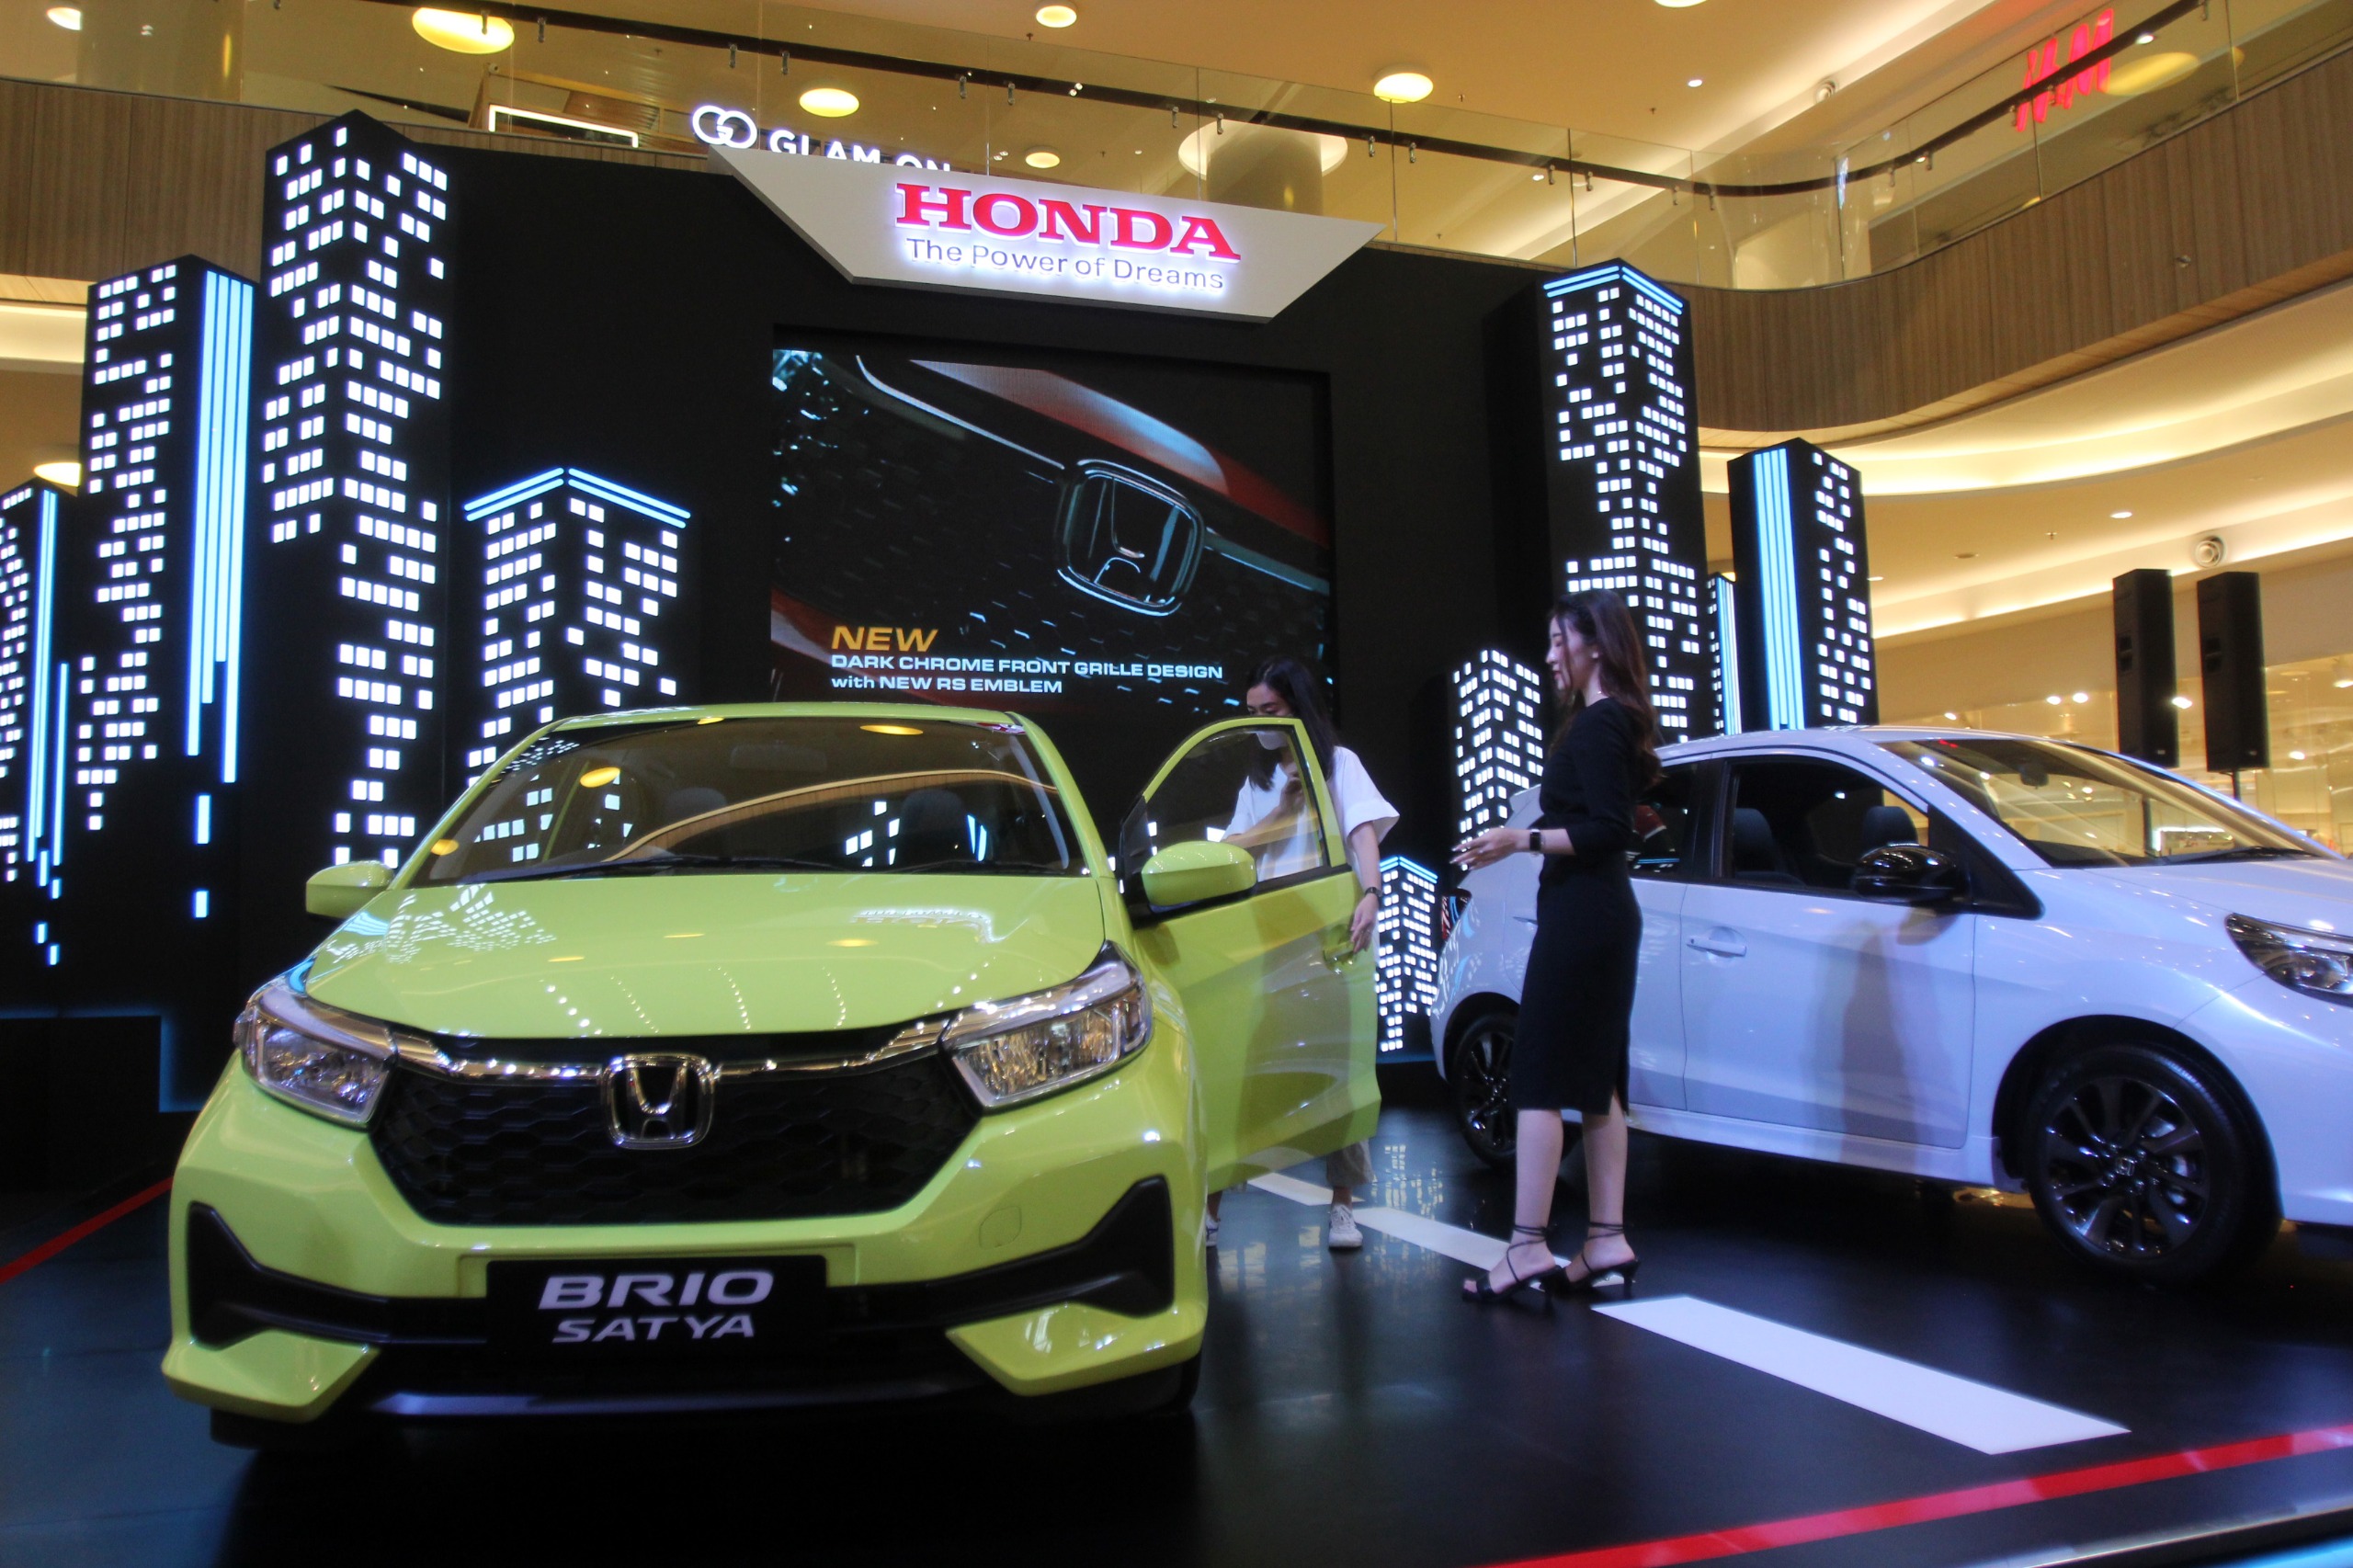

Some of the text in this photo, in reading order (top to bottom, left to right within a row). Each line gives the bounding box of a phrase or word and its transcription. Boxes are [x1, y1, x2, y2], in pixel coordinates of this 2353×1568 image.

[895, 182, 1242, 263] HONDA
[905, 237, 1223, 290] The Power of Dreams
[831, 625, 938, 653] NEW
[831, 654, 1222, 678] DARK CHROME FRONT GRILLE DESIGN
[831, 676, 1063, 693] with NEW RS EMBLEM
[538, 1270, 774, 1310] BRIO
[551, 1314, 756, 1343] SATYA
